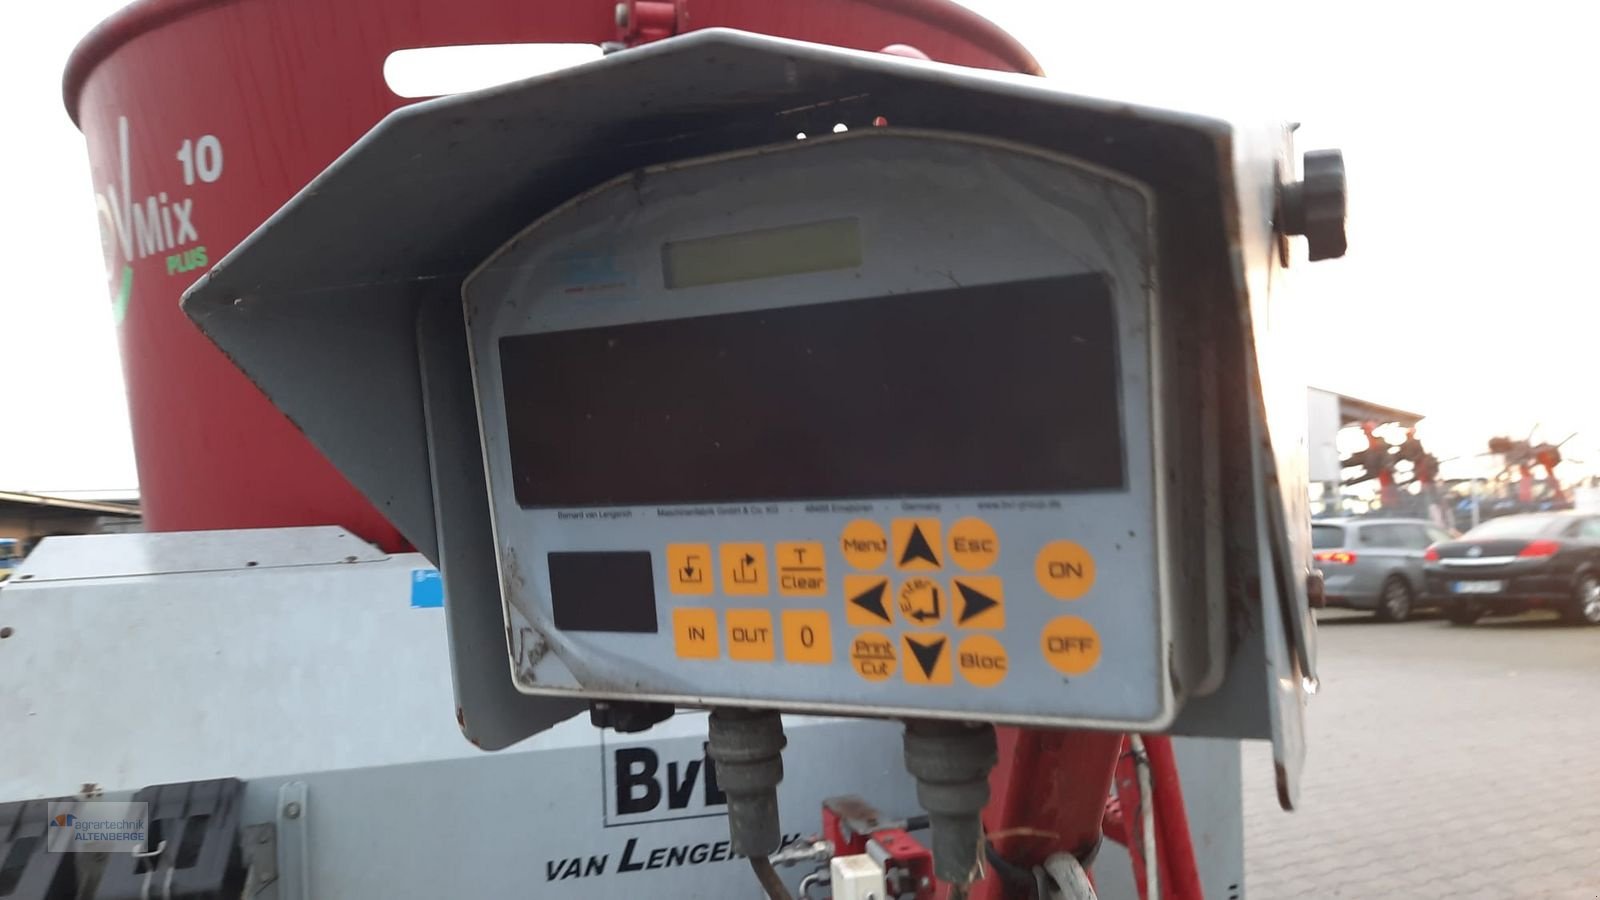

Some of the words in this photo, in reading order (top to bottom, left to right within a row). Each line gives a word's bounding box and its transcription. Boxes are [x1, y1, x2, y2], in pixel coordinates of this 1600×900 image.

[176, 134, 223, 186] 10
[167, 246, 208, 275] PLUS
[557, 511, 584, 519] Bernard
[599, 510, 632, 520] Lengerich
[843, 537, 887, 553] Menu
[954, 537, 993, 553] Esc
[794, 548, 806, 563] T
[1048, 561, 1083, 579] ON
[781, 575, 824, 589] Clear
[900, 579, 932, 613] Enter
[688, 627, 705, 641] IN
[733, 627, 768, 642] OUT
[855, 640, 893, 655] Print
[1047, 636, 1093, 655] OFF
[861, 660, 888, 676] Cut
[960, 653, 1006, 671] Bloc
[545, 854, 609, 882] VAN
